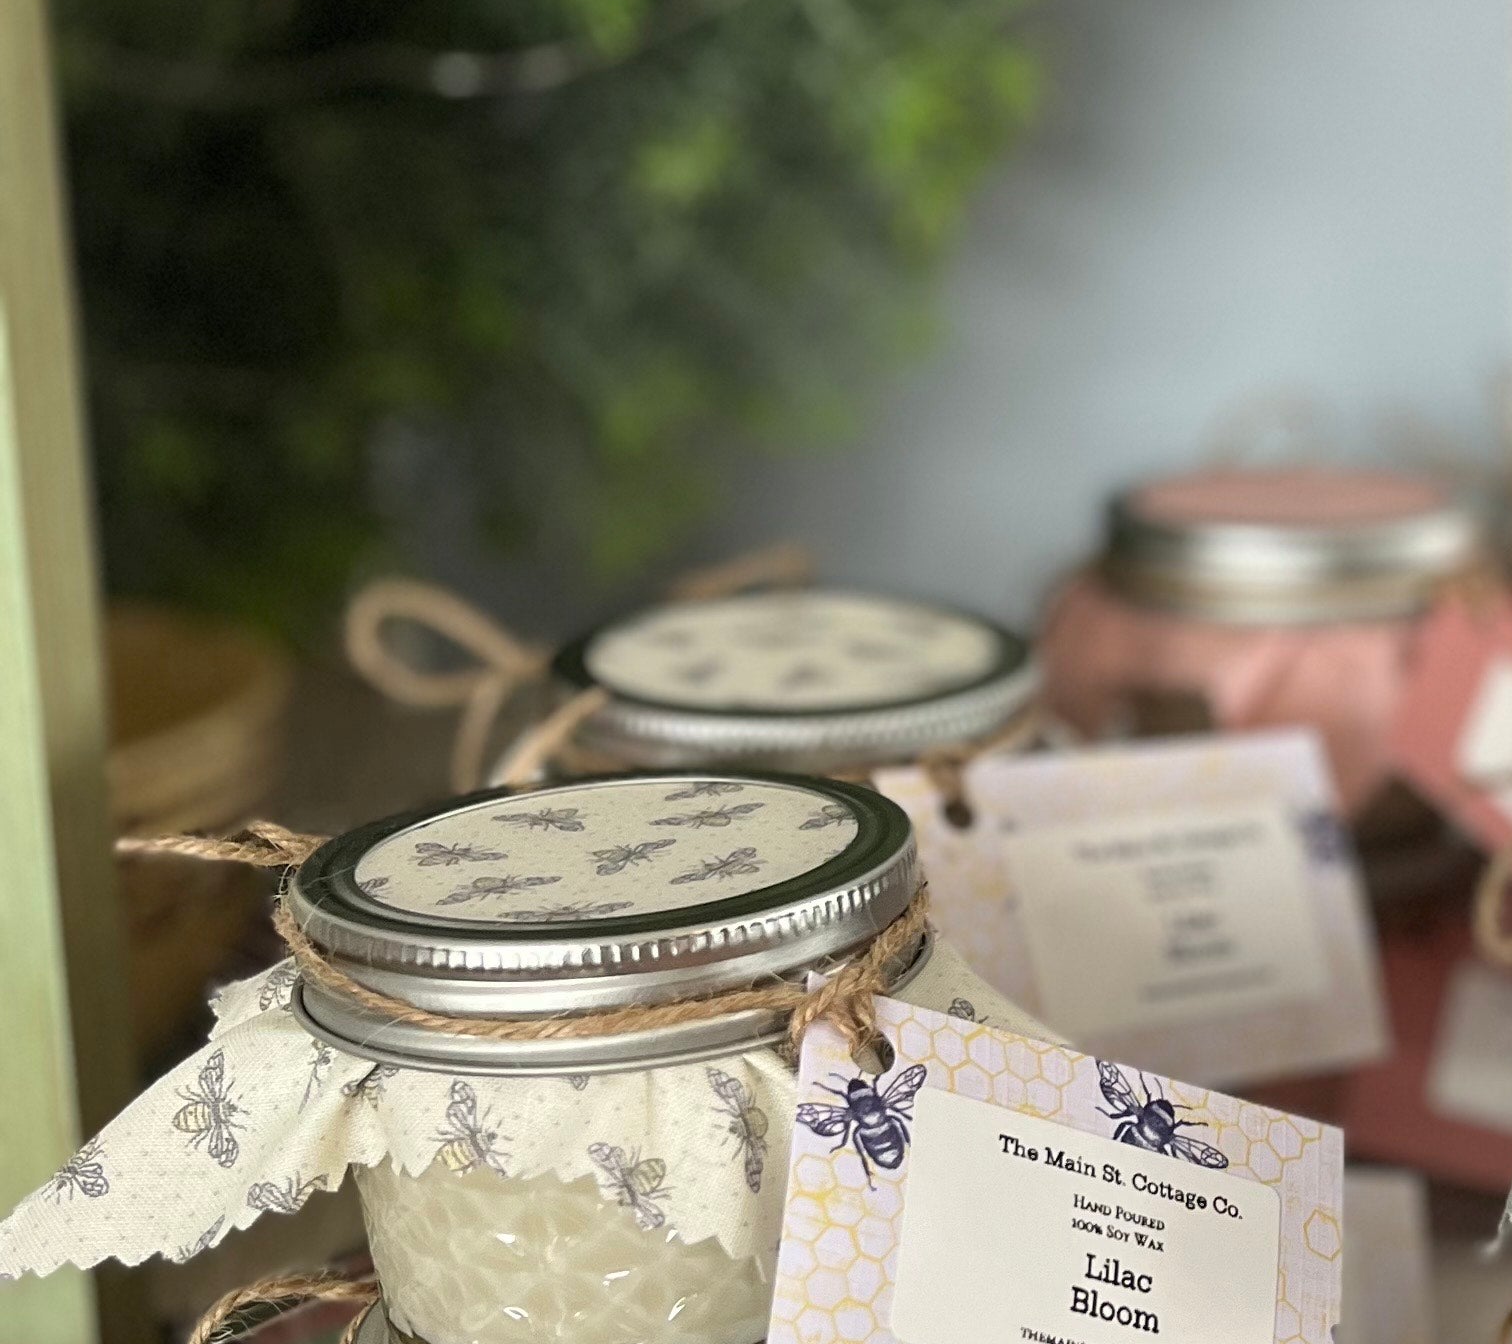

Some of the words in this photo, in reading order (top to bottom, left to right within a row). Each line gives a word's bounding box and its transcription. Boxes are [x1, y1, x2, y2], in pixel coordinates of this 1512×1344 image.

[999, 1134, 1038, 1161] The
[1045, 1147, 1096, 1177] Main
[1102, 1164, 1125, 1186] St.
[1132, 1174, 1207, 1210] Cottage
[1212, 1196, 1243, 1219] Co.
[1074, 1194, 1112, 1216] HAND
[1085, 1253, 1153, 1293] Lilac
[1070, 1286, 1160, 1334] Bloom
